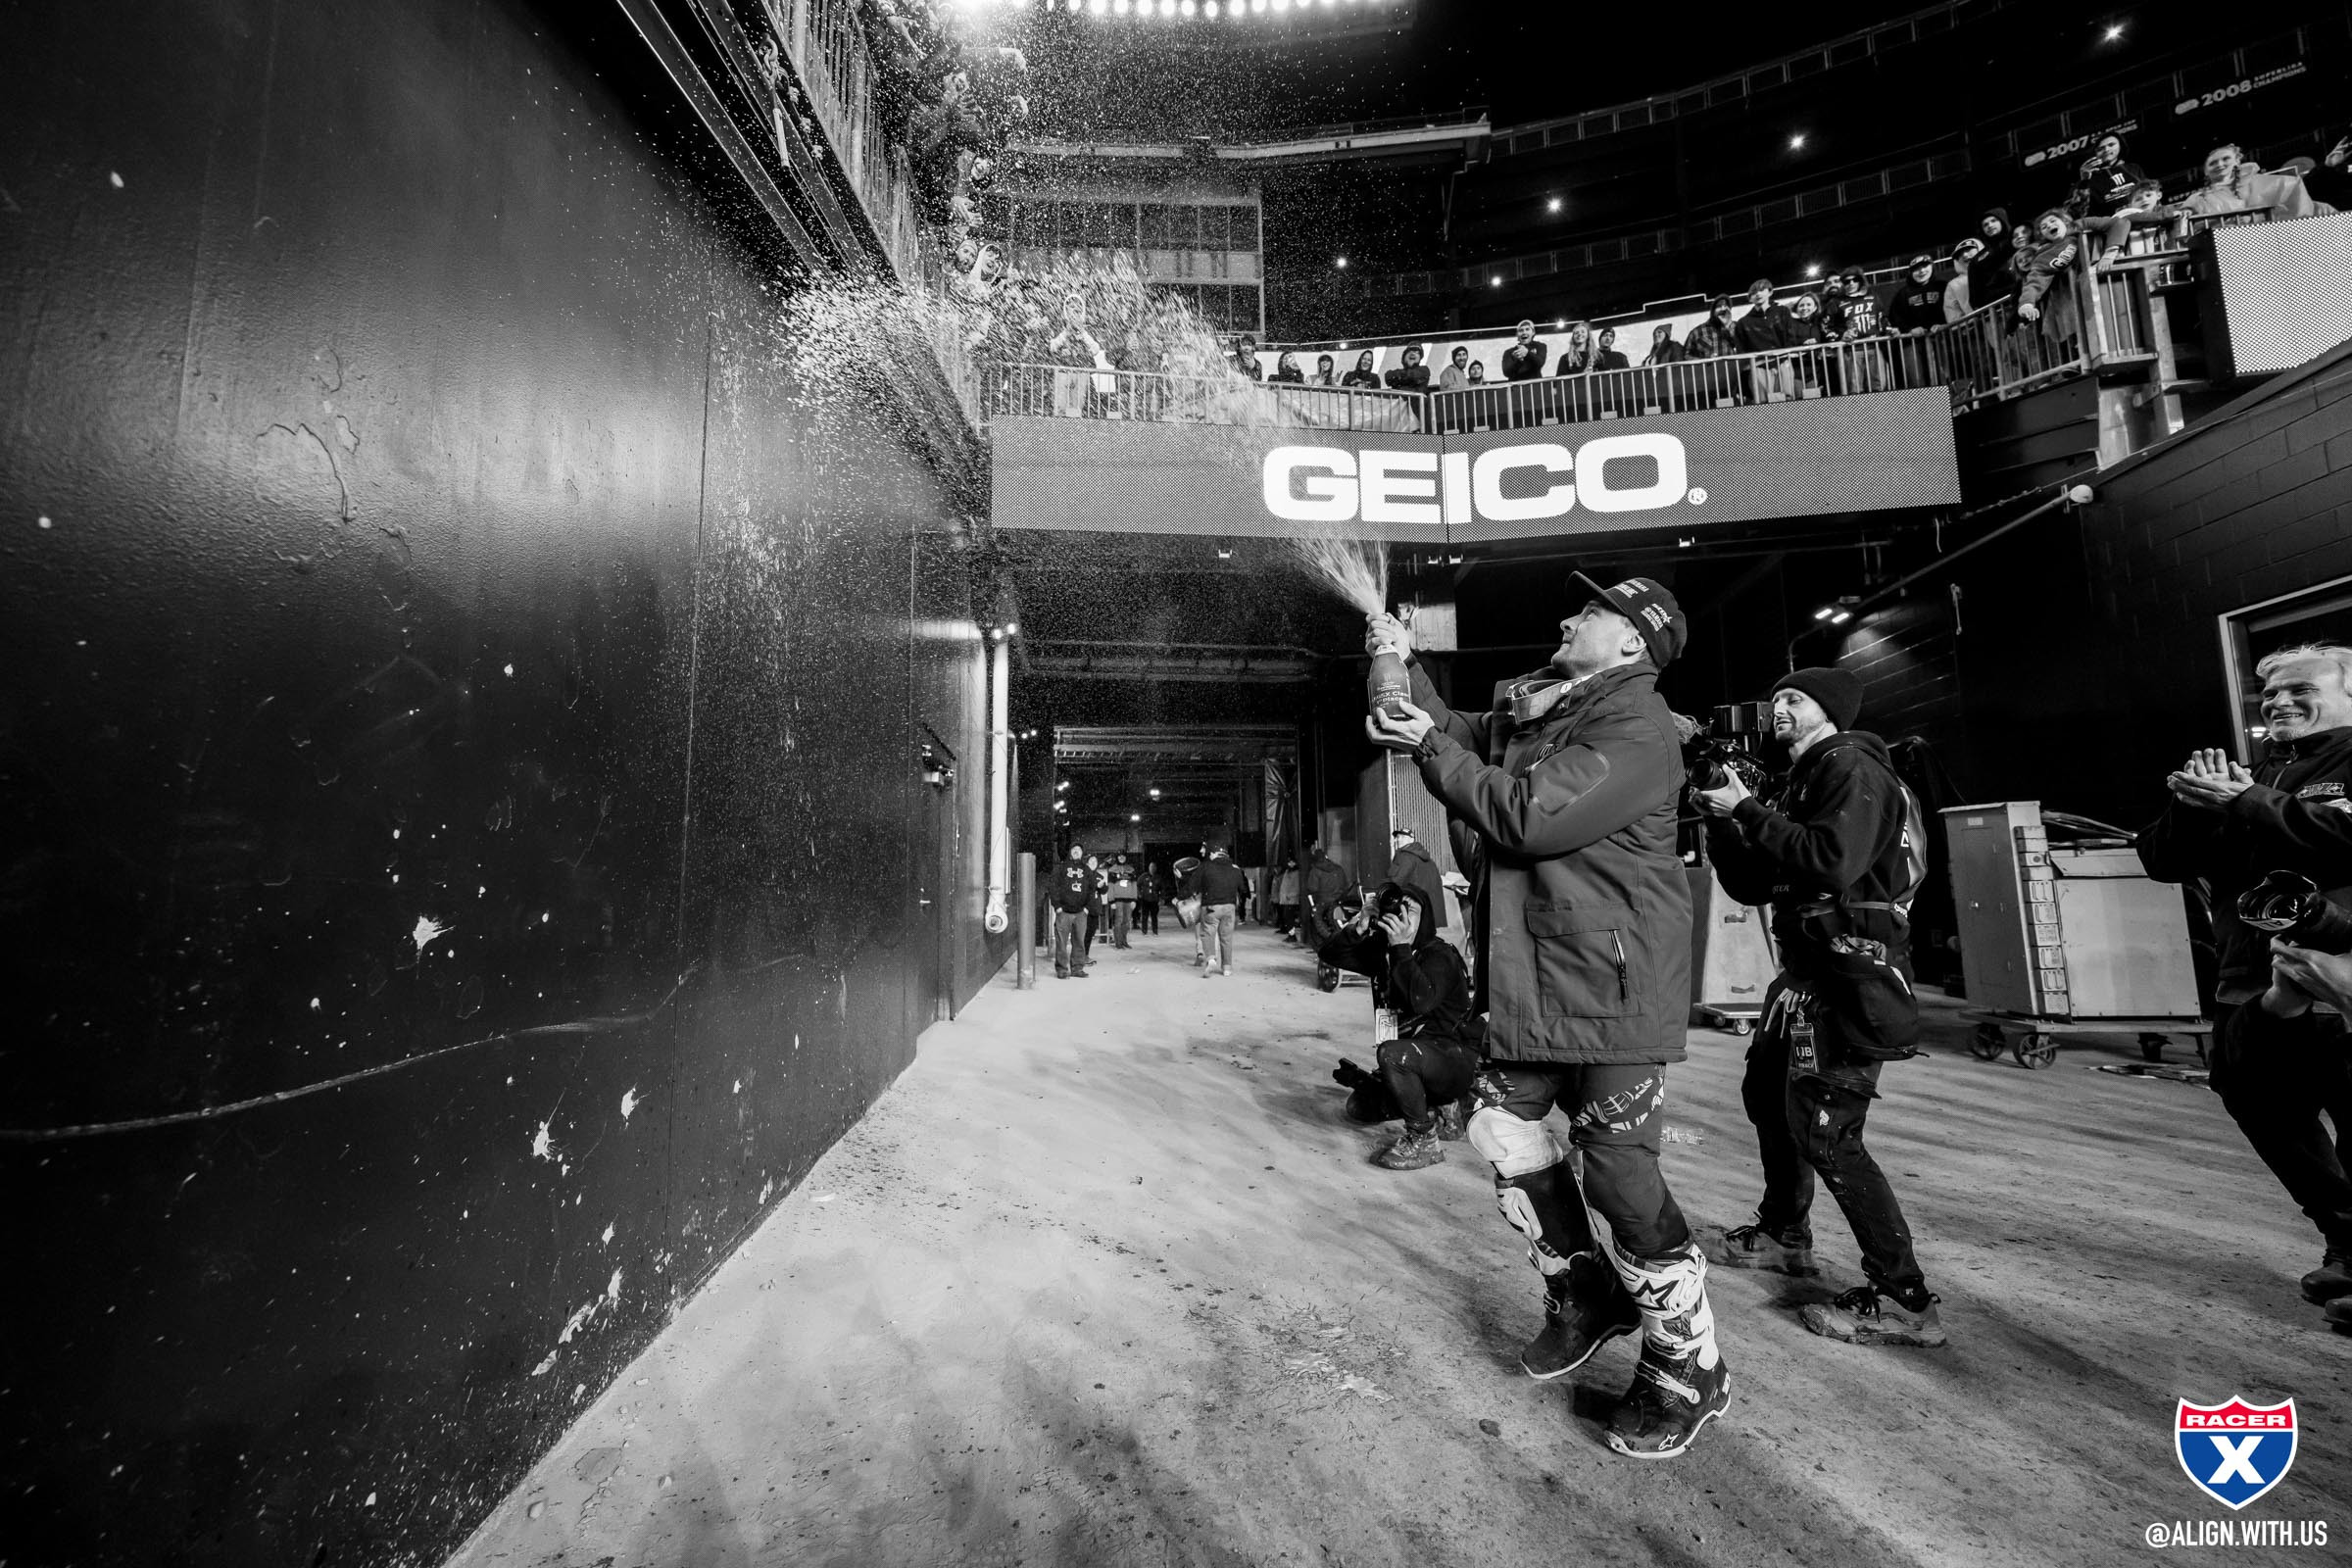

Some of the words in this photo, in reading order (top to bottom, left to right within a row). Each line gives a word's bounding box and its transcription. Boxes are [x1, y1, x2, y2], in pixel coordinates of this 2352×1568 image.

[2201, 79, 2252, 107] 2008
[2253, 66, 2307, 88] CHAMPIONS
[2047, 135, 2089, 160] 2007
[1844, 302, 1874, 318] FOX
[1263, 433, 1688, 524] GEICO
